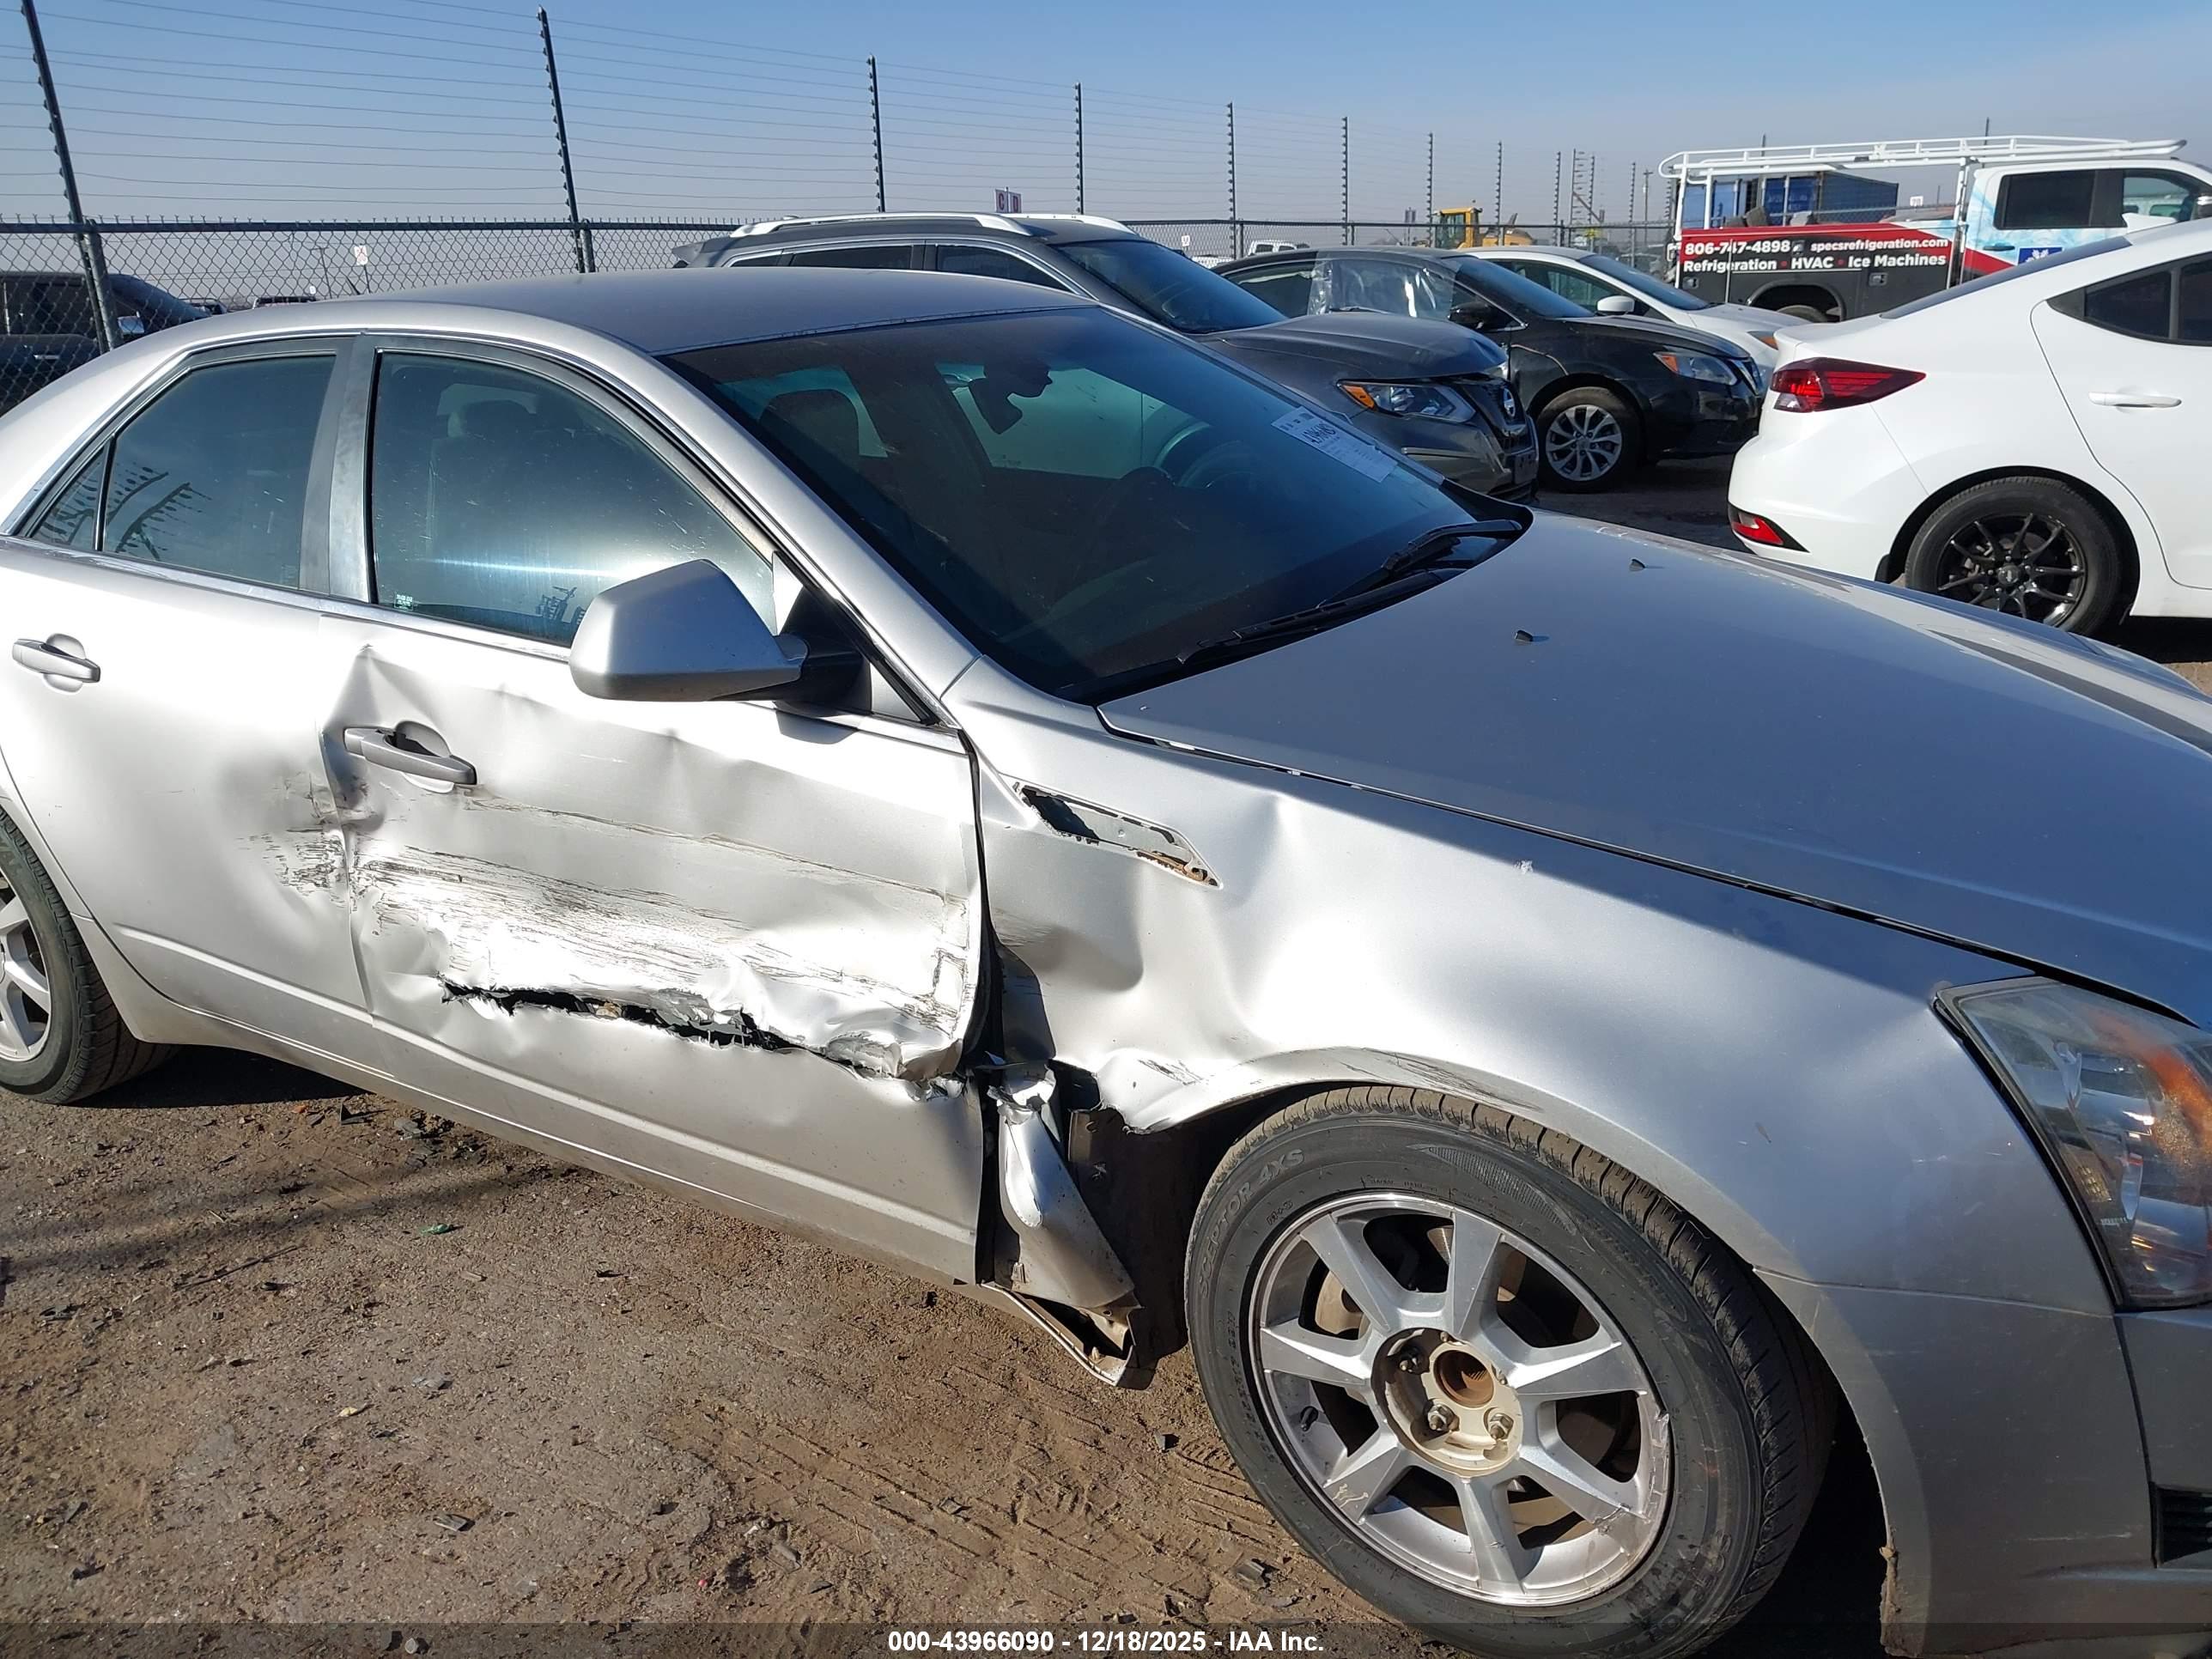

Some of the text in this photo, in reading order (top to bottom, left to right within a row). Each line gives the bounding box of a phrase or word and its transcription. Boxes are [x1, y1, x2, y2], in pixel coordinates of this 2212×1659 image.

[999, 193, 1005, 210] C
[1685, 240, 1791, 256] 806-747-4898
[1810, 237, 1949, 252] specsrefrigeration.com
[1683, 252, 1948, 274] Refrigeration HVAC Ice Machines
